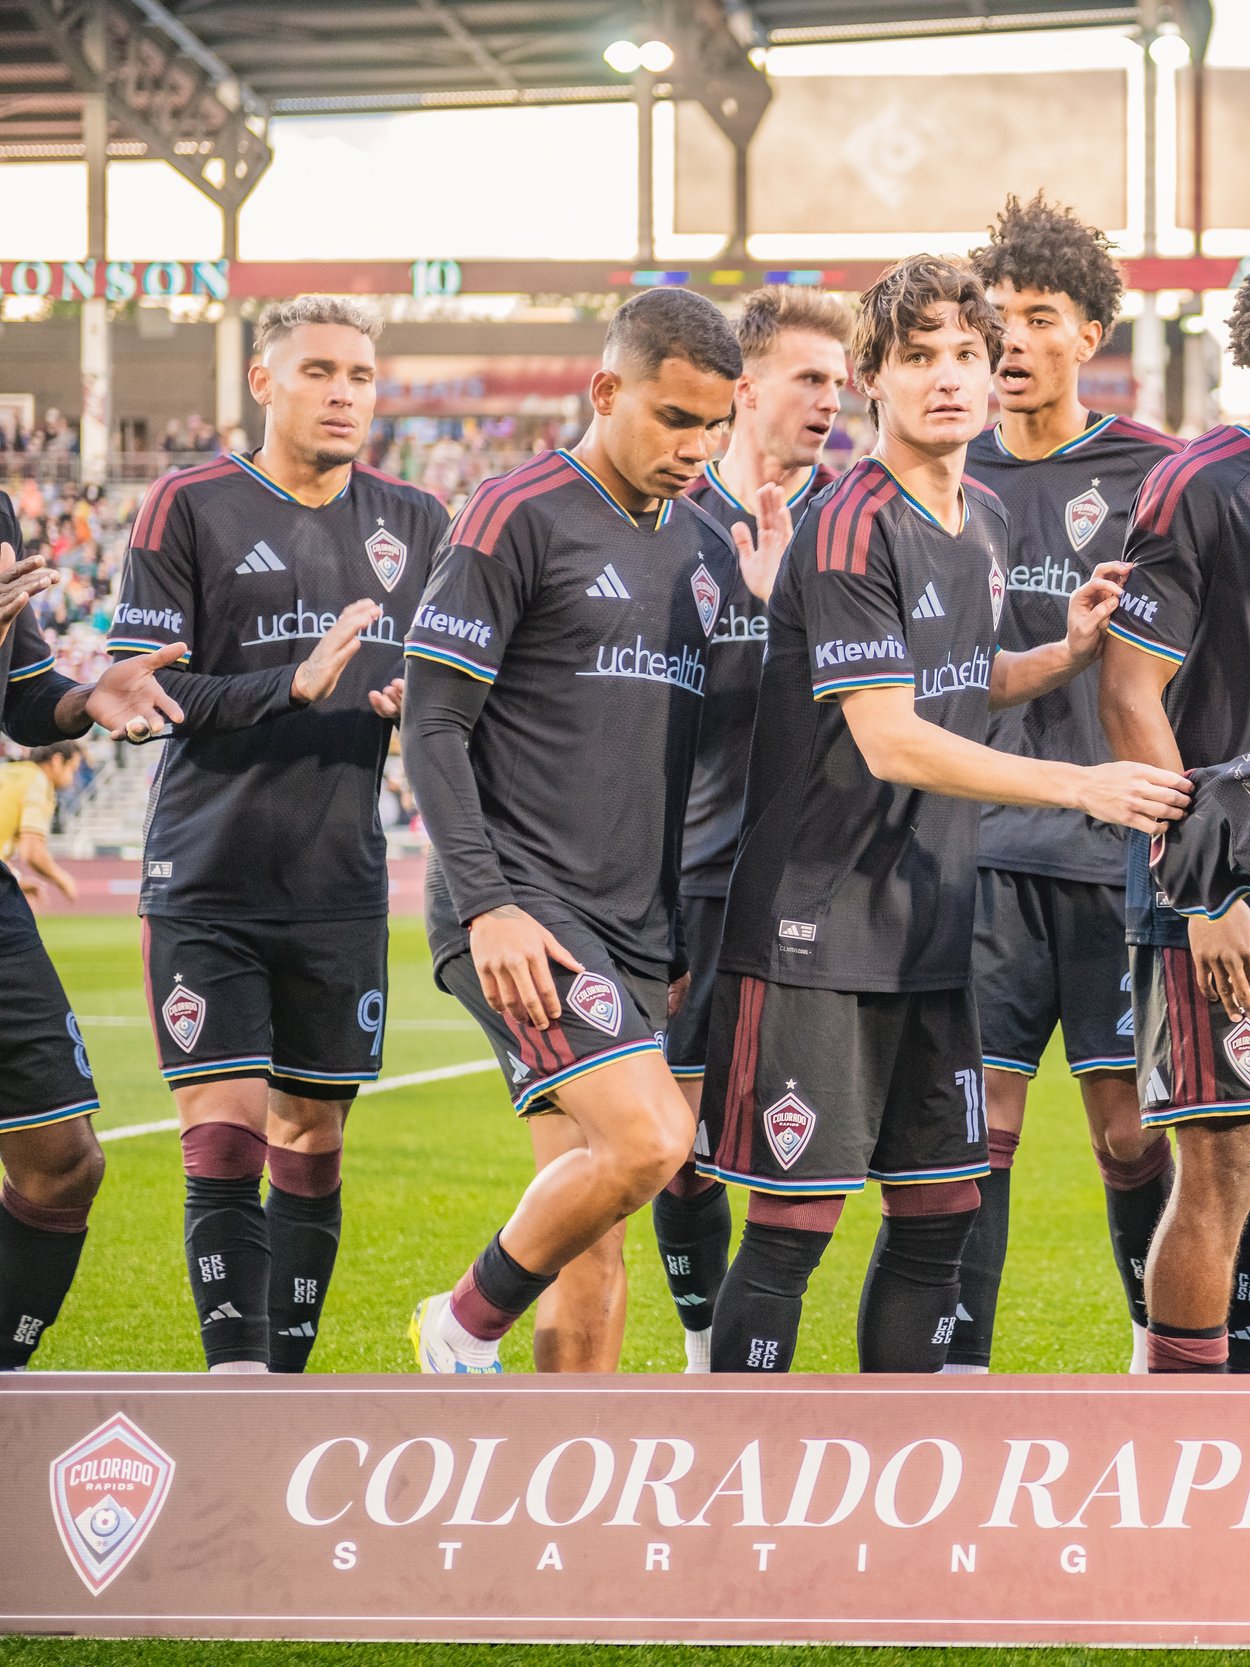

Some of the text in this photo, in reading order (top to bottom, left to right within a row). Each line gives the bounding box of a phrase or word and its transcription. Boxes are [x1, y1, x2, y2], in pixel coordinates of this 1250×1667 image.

[0, 258, 230, 300] ONSON
[410, 258, 462, 299] 10
[1007, 556, 1082, 597] ealth
[1119, 590, 1158, 622] wit
[596, 635, 706, 696] uchealth
[815, 634, 906, 668] Kiewit
[356, 988, 384, 1057] 9
[772, 1112, 807, 1126] COLORADO
[954, 1068, 989, 1144] 1
[70, 1457, 153, 1487] COLORADO
[85, 1482, 135, 1491] RAPIDS
[286, 1436, 964, 1529] COLORADO
[332, 1541, 1088, 1575] STARTING
